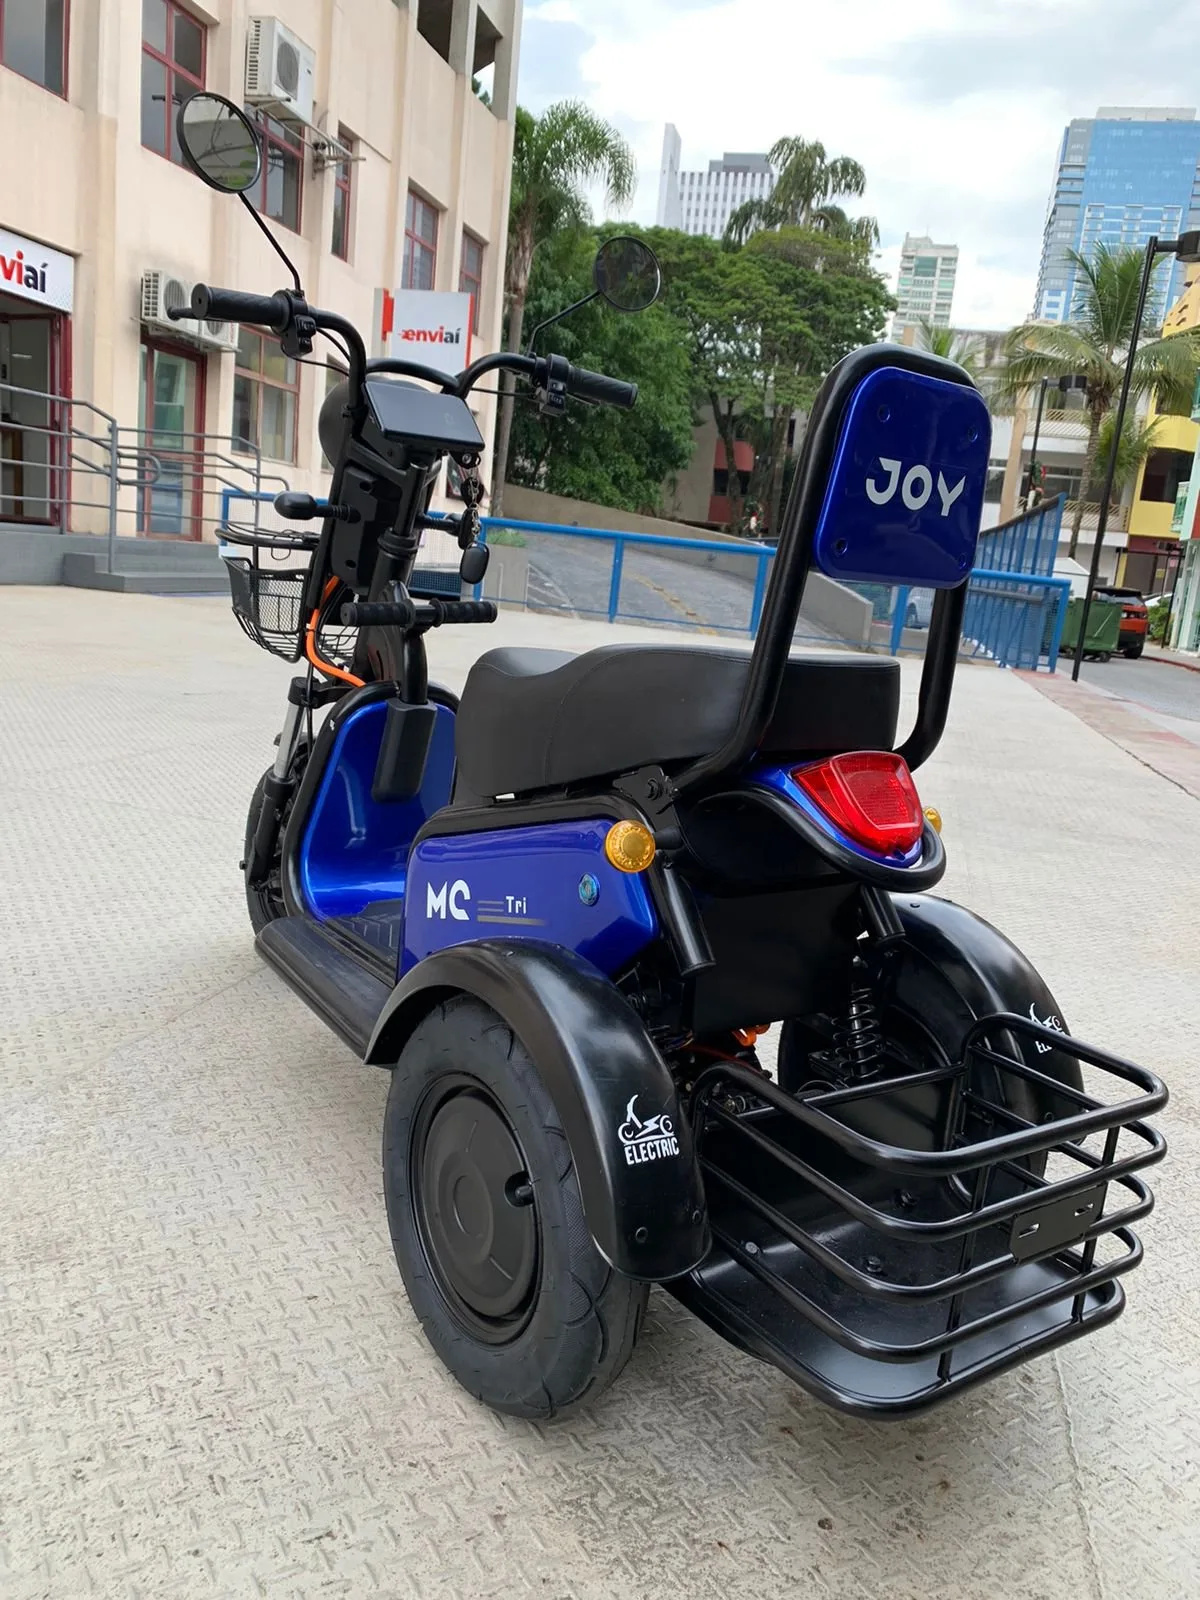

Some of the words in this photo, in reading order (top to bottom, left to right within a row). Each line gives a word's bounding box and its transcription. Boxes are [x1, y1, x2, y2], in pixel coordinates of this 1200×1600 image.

[401, 325, 461, 344] enviaí
[866, 456, 966, 517] JOY
[505, 896, 527, 914] Tri
[624, 1137, 680, 1166] ELECTRIC
